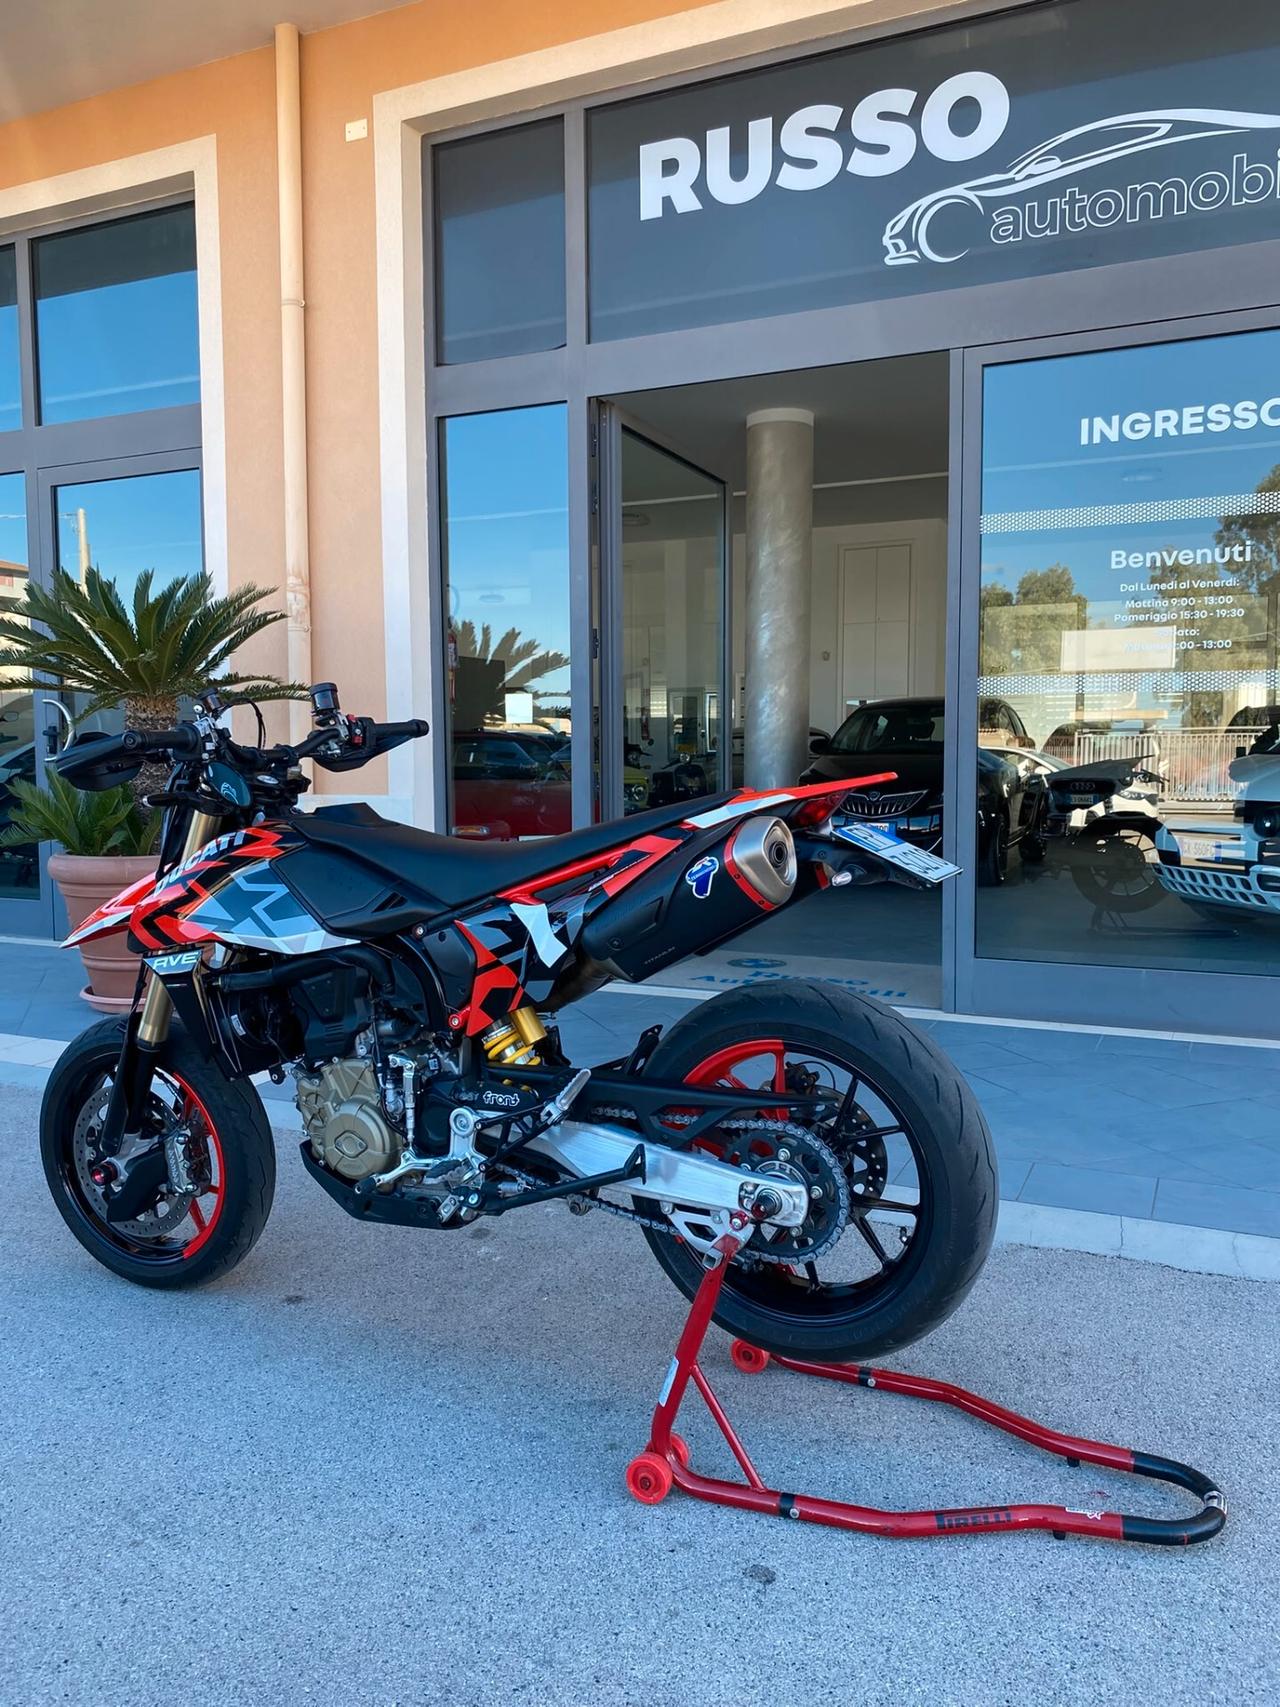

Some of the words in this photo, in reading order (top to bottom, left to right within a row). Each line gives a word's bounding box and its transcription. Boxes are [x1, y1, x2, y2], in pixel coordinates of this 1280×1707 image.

[640, 71, 1011, 222] RUSSO
[990, 148, 1280, 244] automob
[1080, 397, 1280, 446] INGRESSO
[1111, 540, 1252, 569] Benvenuti
[1120, 583, 1139, 593] Dal
[1179, 581, 1190, 590] al
[1125, 599, 1169, 609] Mattina
[1170, 597, 1196, 607] 9:00
[1204, 595, 1234, 606] 13:00
[1114, 611, 1179, 623] Pomeriggio
[1180, 609, 1208, 620] 15:30
[1215, 608, 1246, 619] 19:30
[1202, 639, 1233, 650] 13:00
[154, 831, 247, 897] DUCATI
[483, 1090, 520, 1107] front
